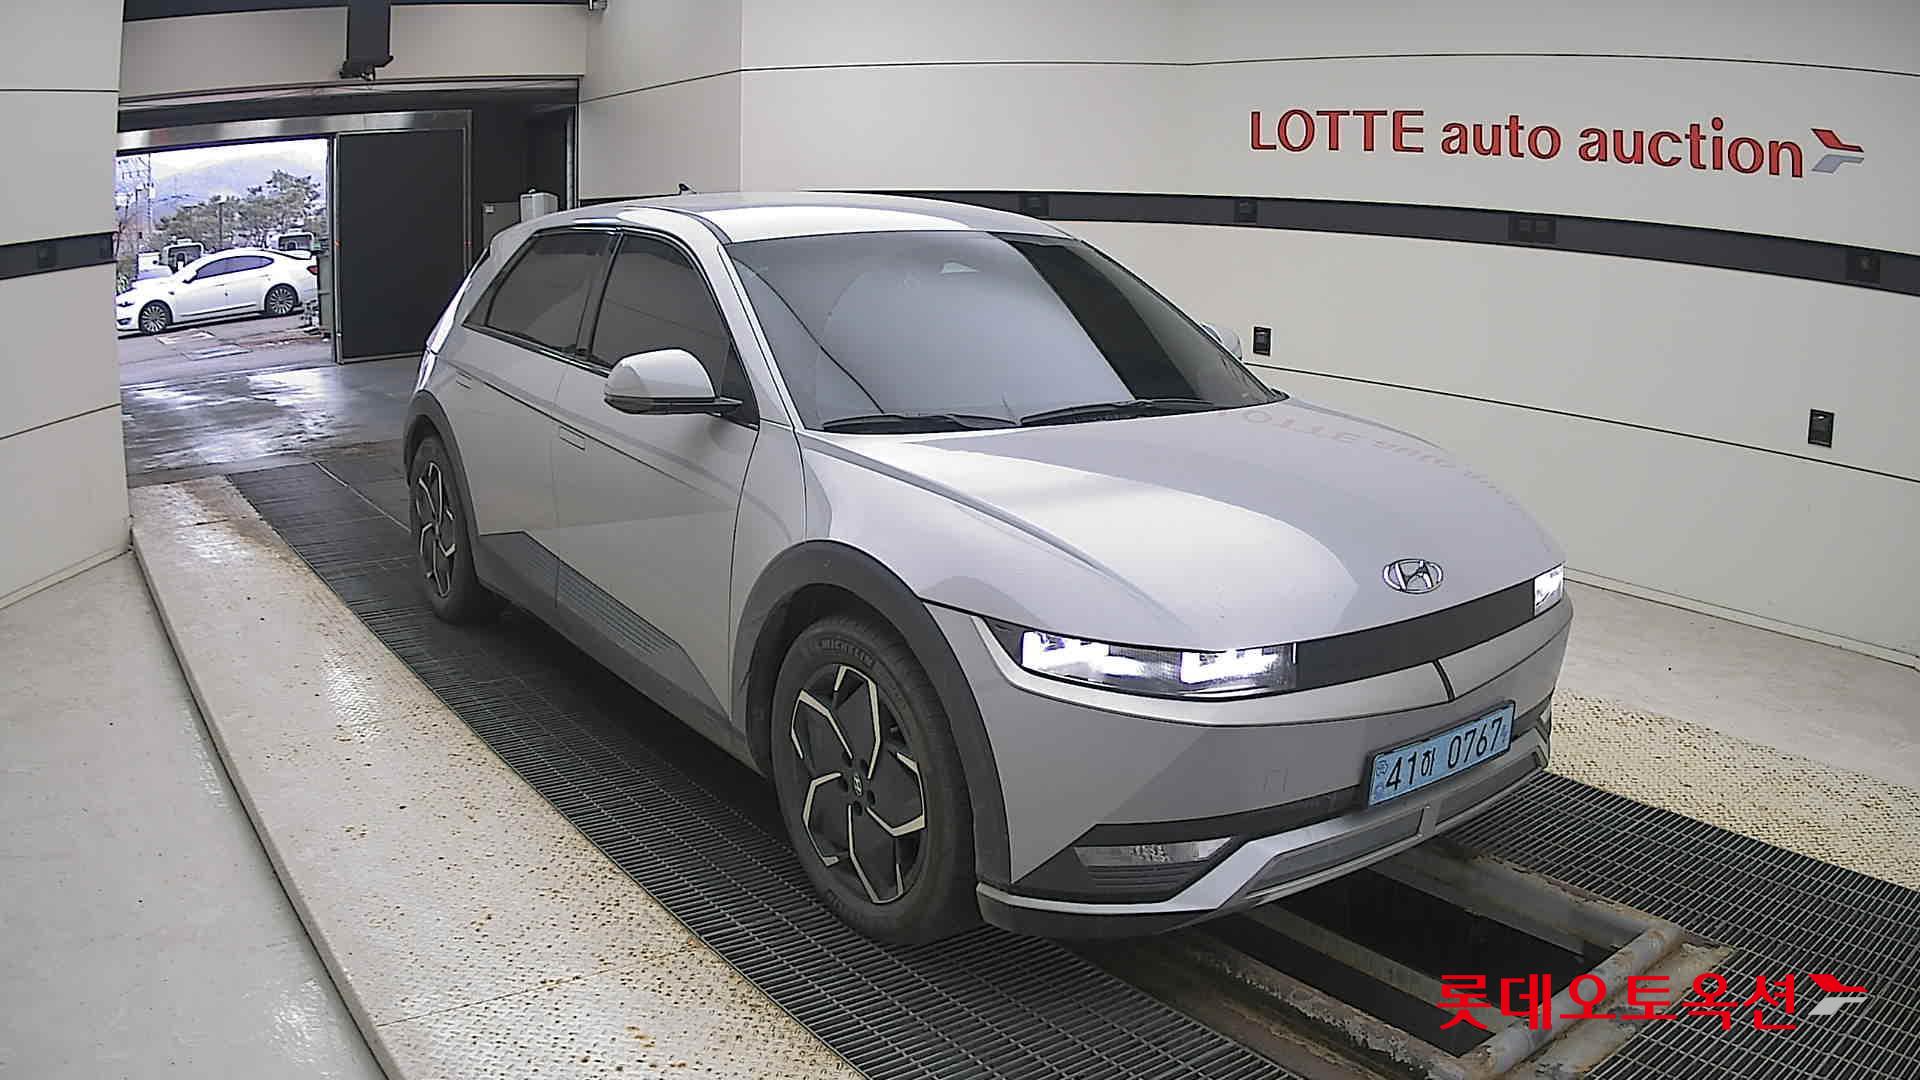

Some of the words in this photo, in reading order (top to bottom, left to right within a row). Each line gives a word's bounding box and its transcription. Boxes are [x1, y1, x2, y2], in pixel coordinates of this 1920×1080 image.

[1250, 110, 1424, 151] LOTTE
[1441, 115, 1561, 159] auto
[1578, 118, 1803, 177] auction
[1386, 748, 1435, 790] 41하
[1447, 717, 1503, 768] 0767
